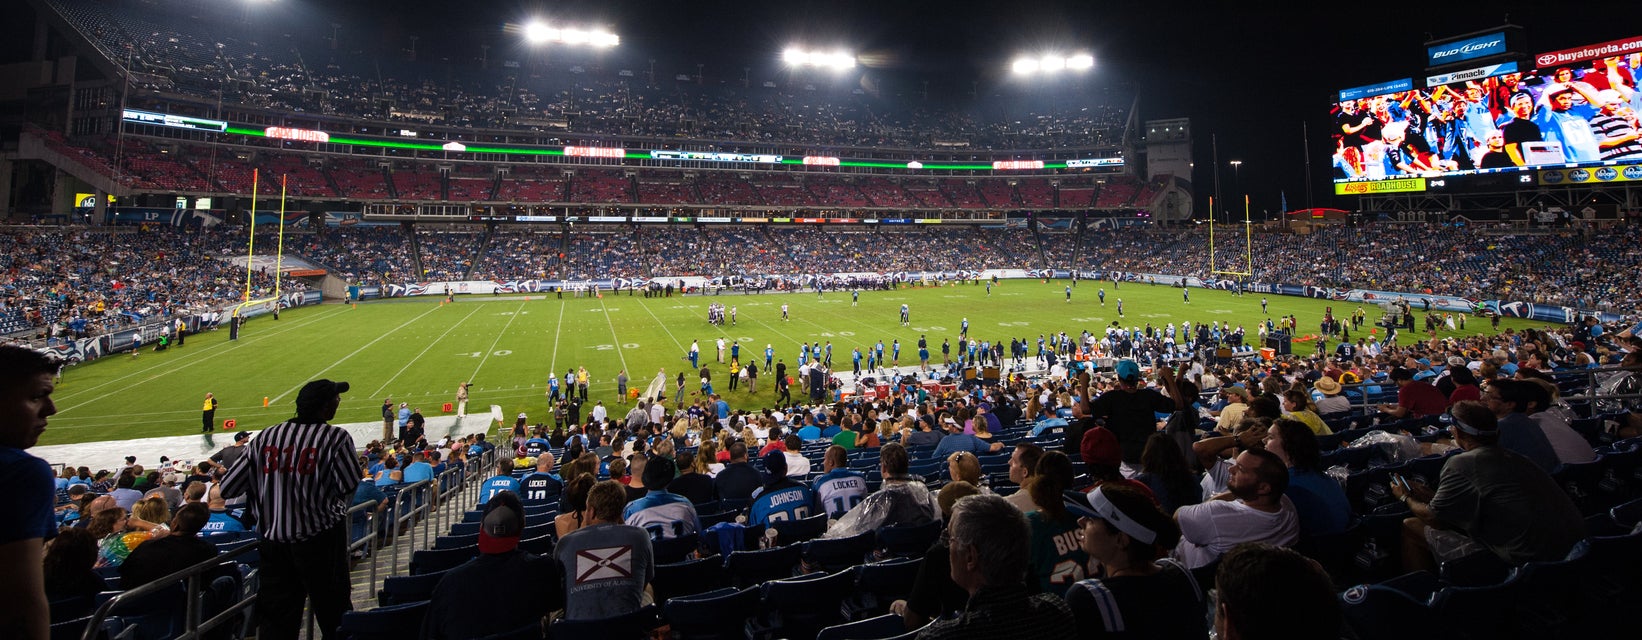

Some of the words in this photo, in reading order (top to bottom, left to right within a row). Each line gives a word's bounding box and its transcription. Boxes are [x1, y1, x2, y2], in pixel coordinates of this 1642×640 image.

[1433, 48, 1459, 59] BUD
[1463, 39, 1501, 53] LIGHT
[1451, 68, 1485, 81] Pinnacle
[1371, 180, 1416, 191] ROADHOUSE
[224, 420, 235, 428] G
[528, 480, 547, 488] LOCKER
[832, 480, 859, 491] LOCKER
[769, 489, 804, 509] JOHNSON
[570, 583, 602, 594] UNIVERSITY
